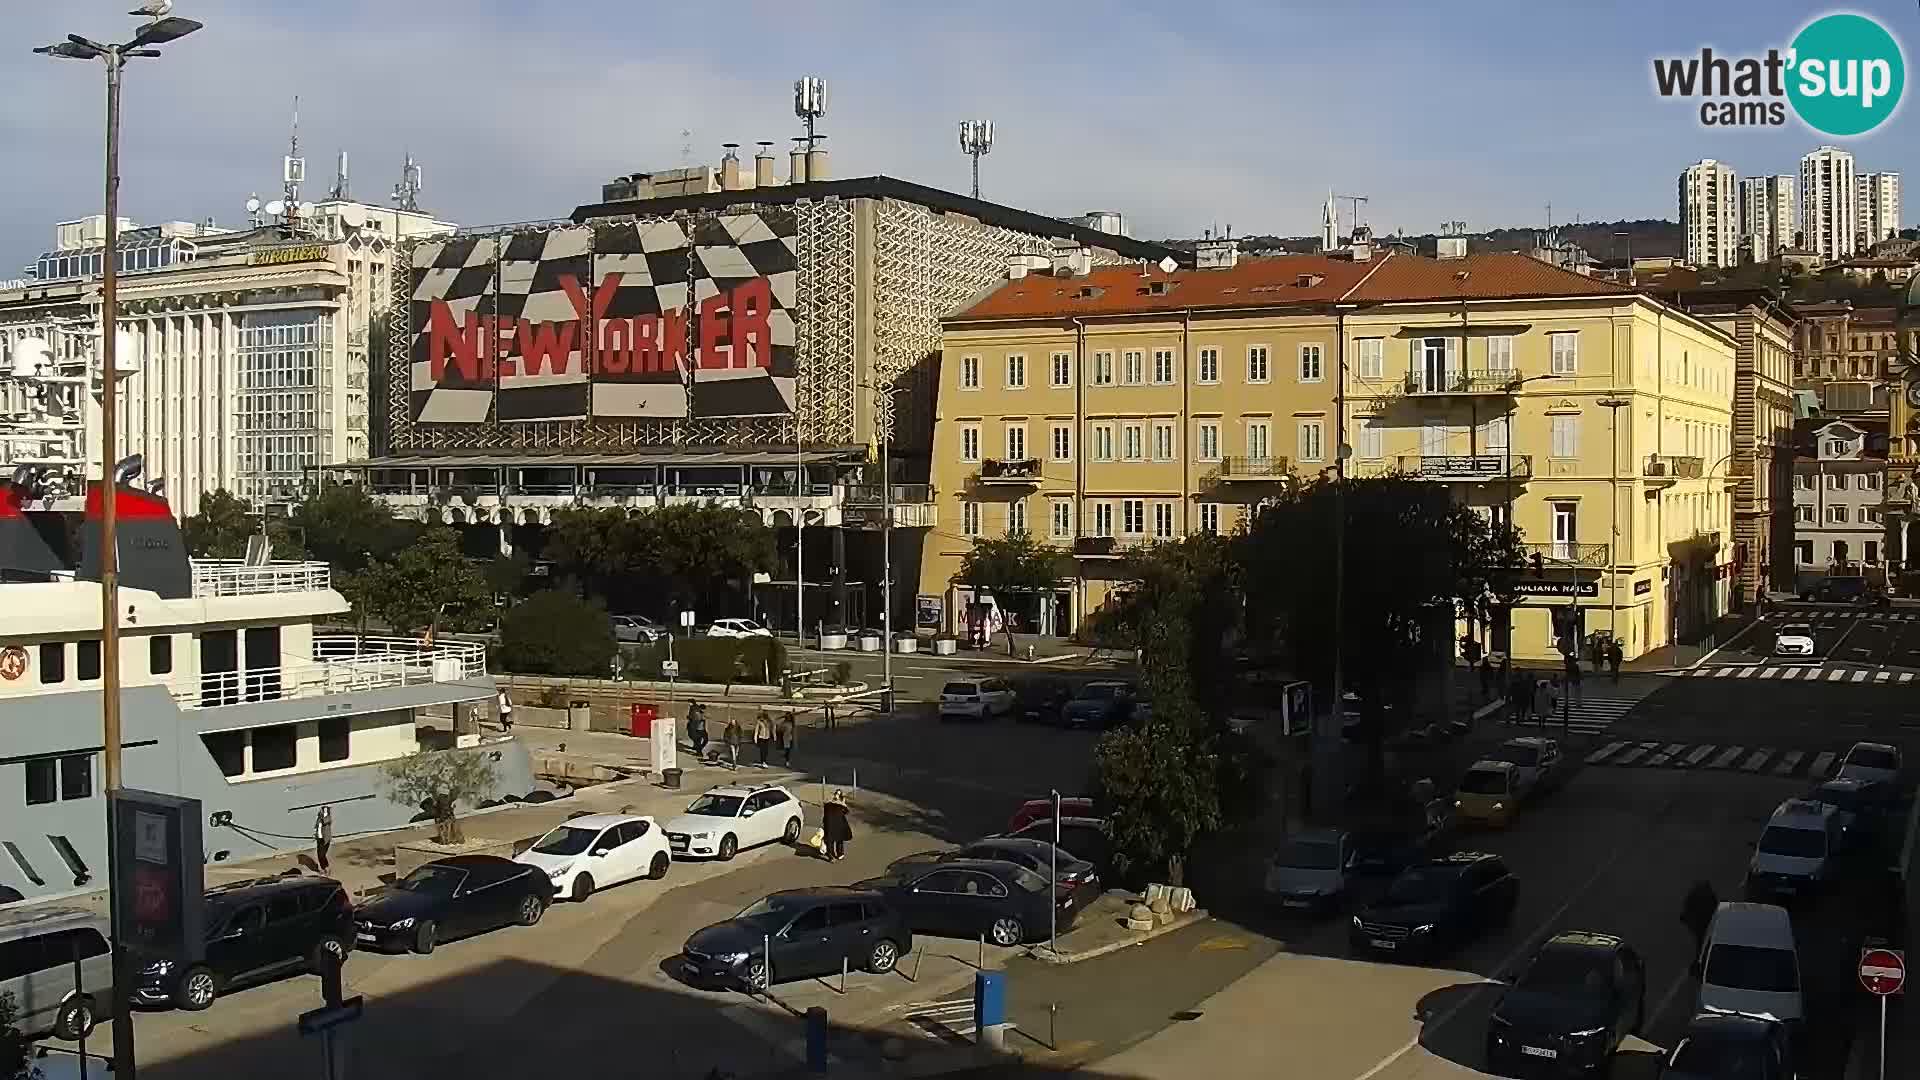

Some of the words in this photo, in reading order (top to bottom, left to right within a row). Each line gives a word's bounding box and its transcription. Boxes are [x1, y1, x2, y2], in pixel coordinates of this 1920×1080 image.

[430, 295, 576, 382] NEW
[560, 272, 773, 377] YORKER
[1562, 585, 1593, 593] NAILS
